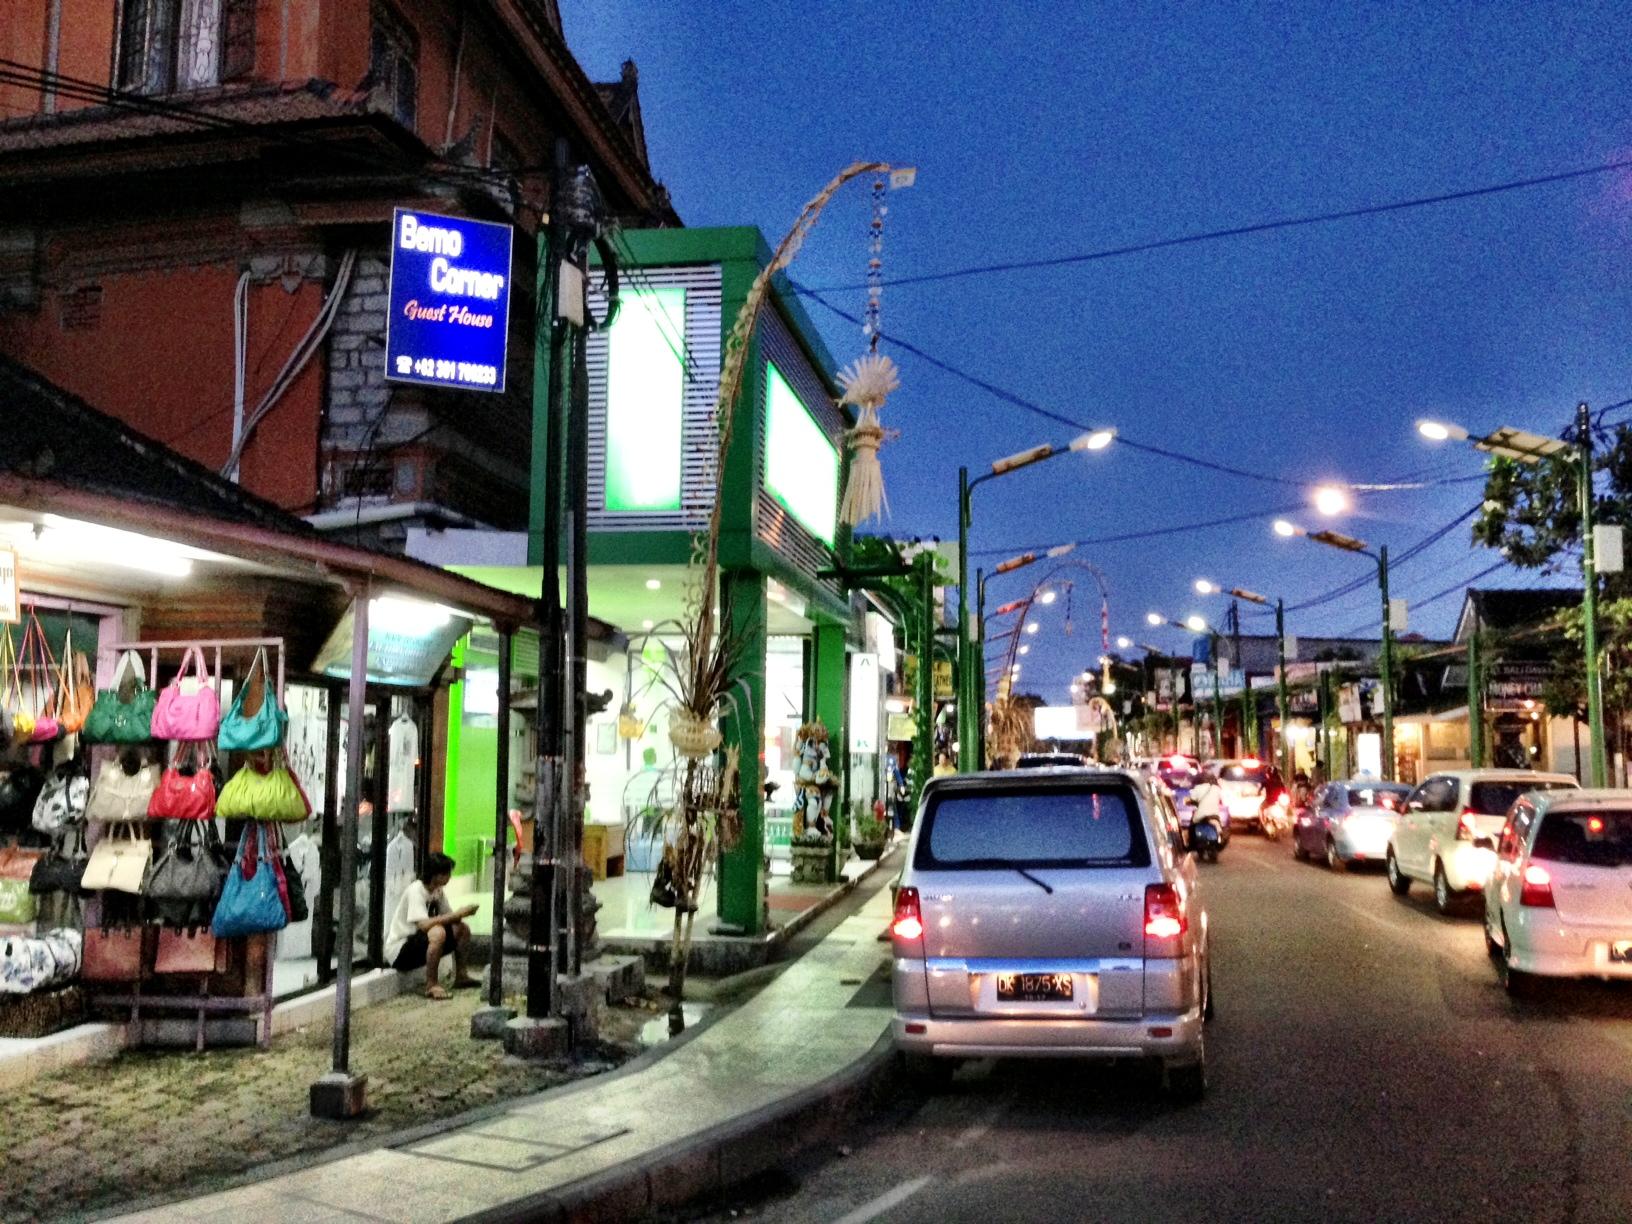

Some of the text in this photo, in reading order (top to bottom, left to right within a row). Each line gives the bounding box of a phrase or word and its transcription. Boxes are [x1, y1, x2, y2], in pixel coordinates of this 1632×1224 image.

[400, 215, 462, 257] Bemo
[430, 258, 504, 300] Corner
[404, 300, 493, 329] Guest House
[998, 974, 1072, 993] DK 1875 XS
